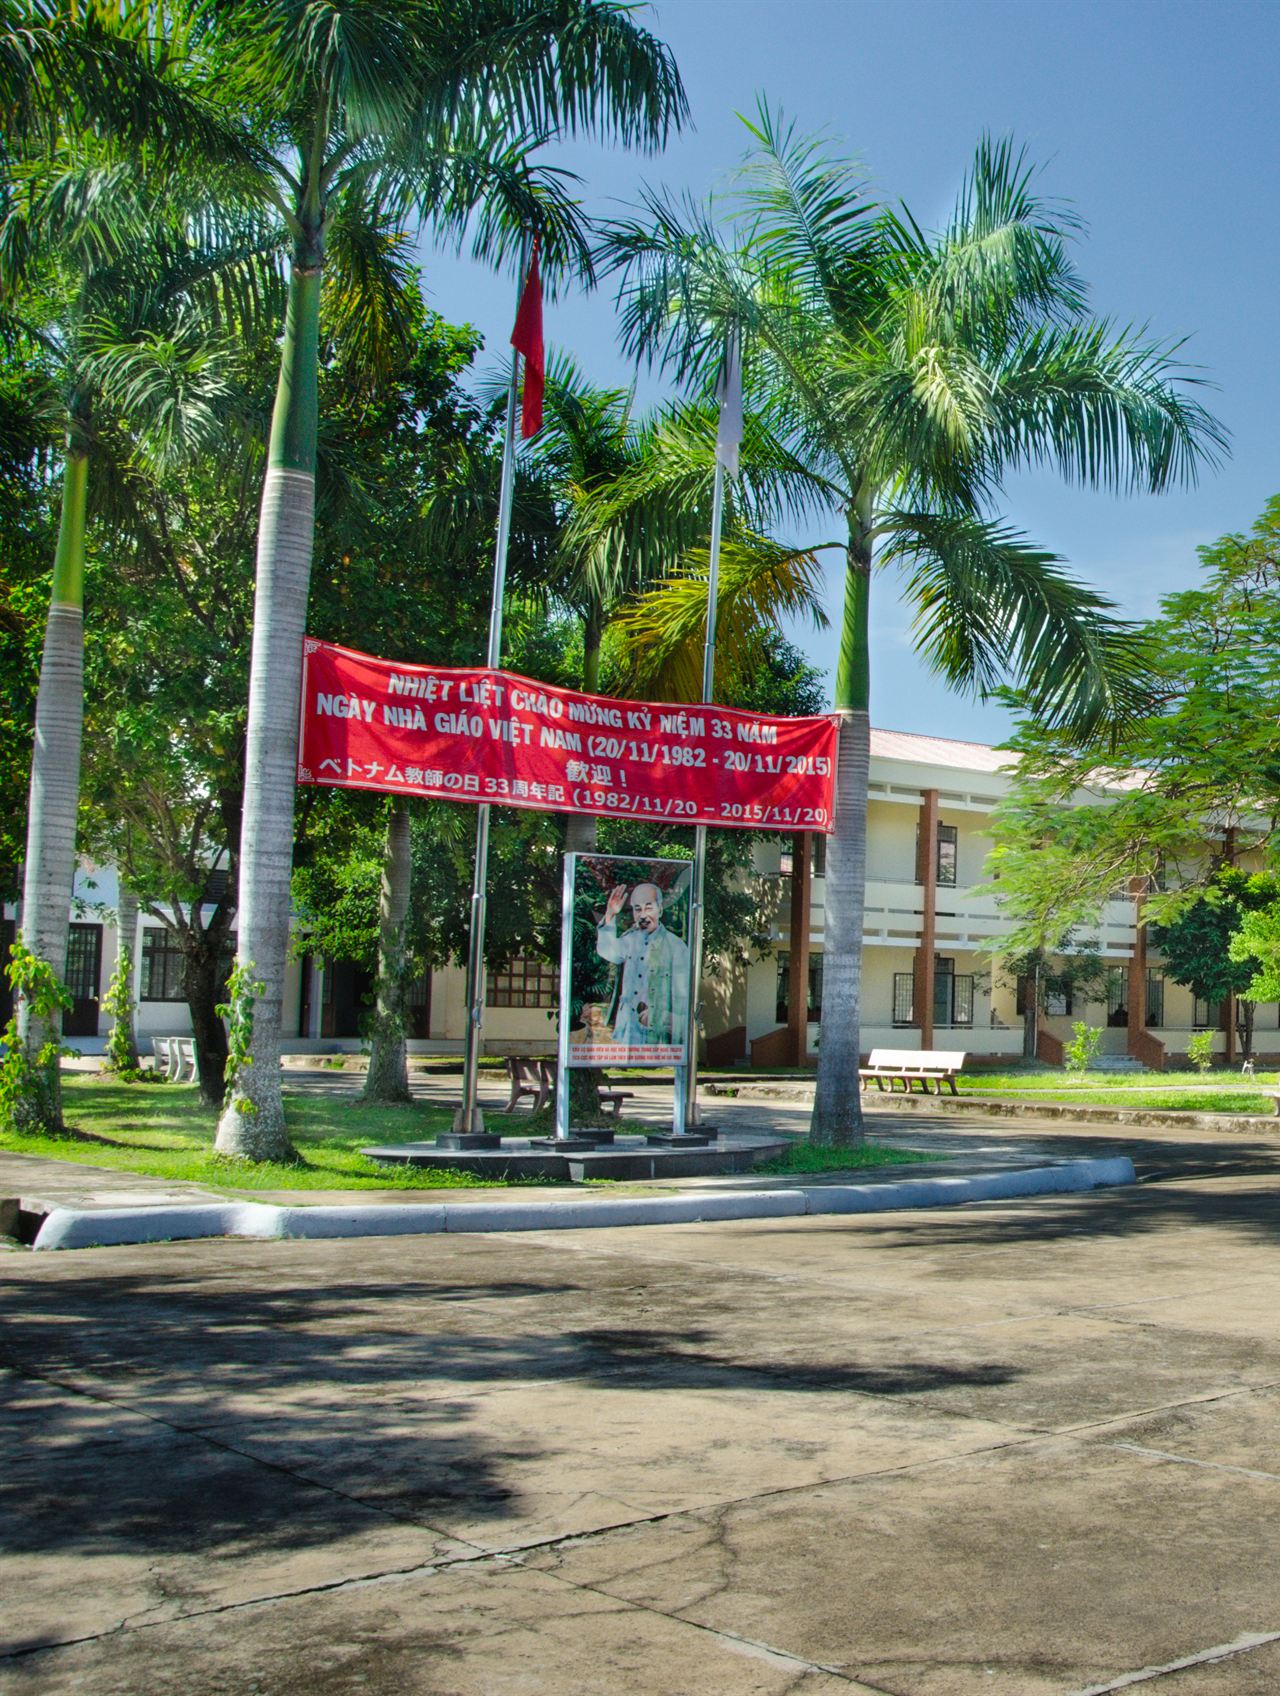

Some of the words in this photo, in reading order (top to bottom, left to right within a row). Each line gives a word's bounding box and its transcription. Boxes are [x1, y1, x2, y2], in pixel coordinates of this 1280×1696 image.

[316, 691, 376, 722] NGÀY
[383, 704, 428, 731] NHÀ
[434, 708, 483, 737] GIÁO
[488, 716, 534, 747] VIỆT
[540, 726, 582, 752] NAM
[388, 672, 454, 703] NHIỆT
[459, 679, 505, 709] LIỆT
[511, 690, 564, 718] CHÀO
[568, 700, 623, 728] MỪNG
[627, 706, 652, 731] KỶ
[659, 711, 706, 739] NIỆM
[711, 719, 733, 739] 33
[737, 720, 778, 745] NĂM
[720, 802, 828, 826] 2015/11/20)
